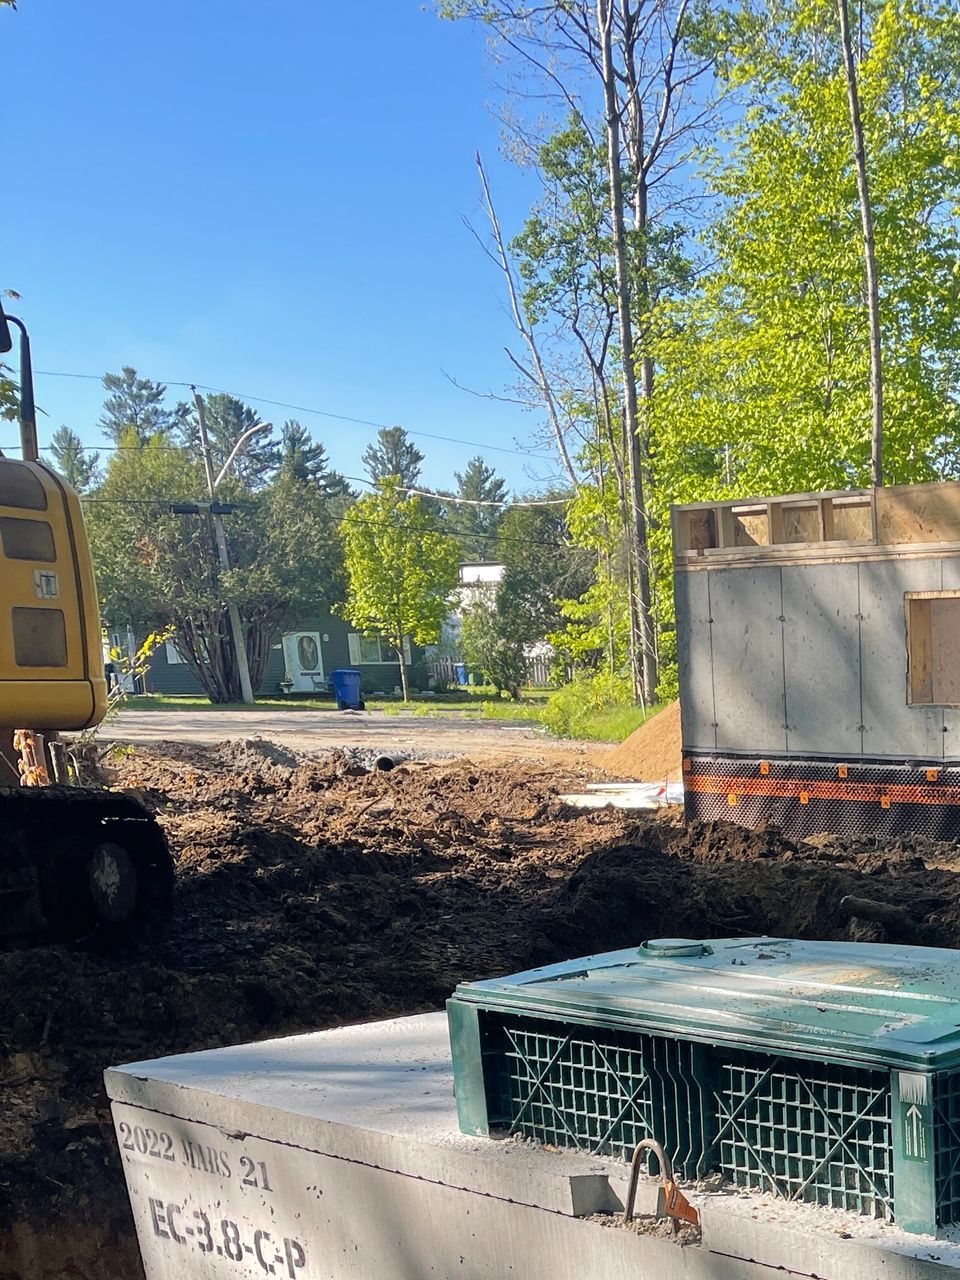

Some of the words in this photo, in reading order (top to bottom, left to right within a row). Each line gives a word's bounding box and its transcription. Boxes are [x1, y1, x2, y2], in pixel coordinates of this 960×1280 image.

[119, 1122, 176, 1162] 2022
[181, 1139, 231, 1178] MARS
[240, 1156, 273, 1192] 21
[148, 1196, 307, 1280] EC-3.8-C-P
